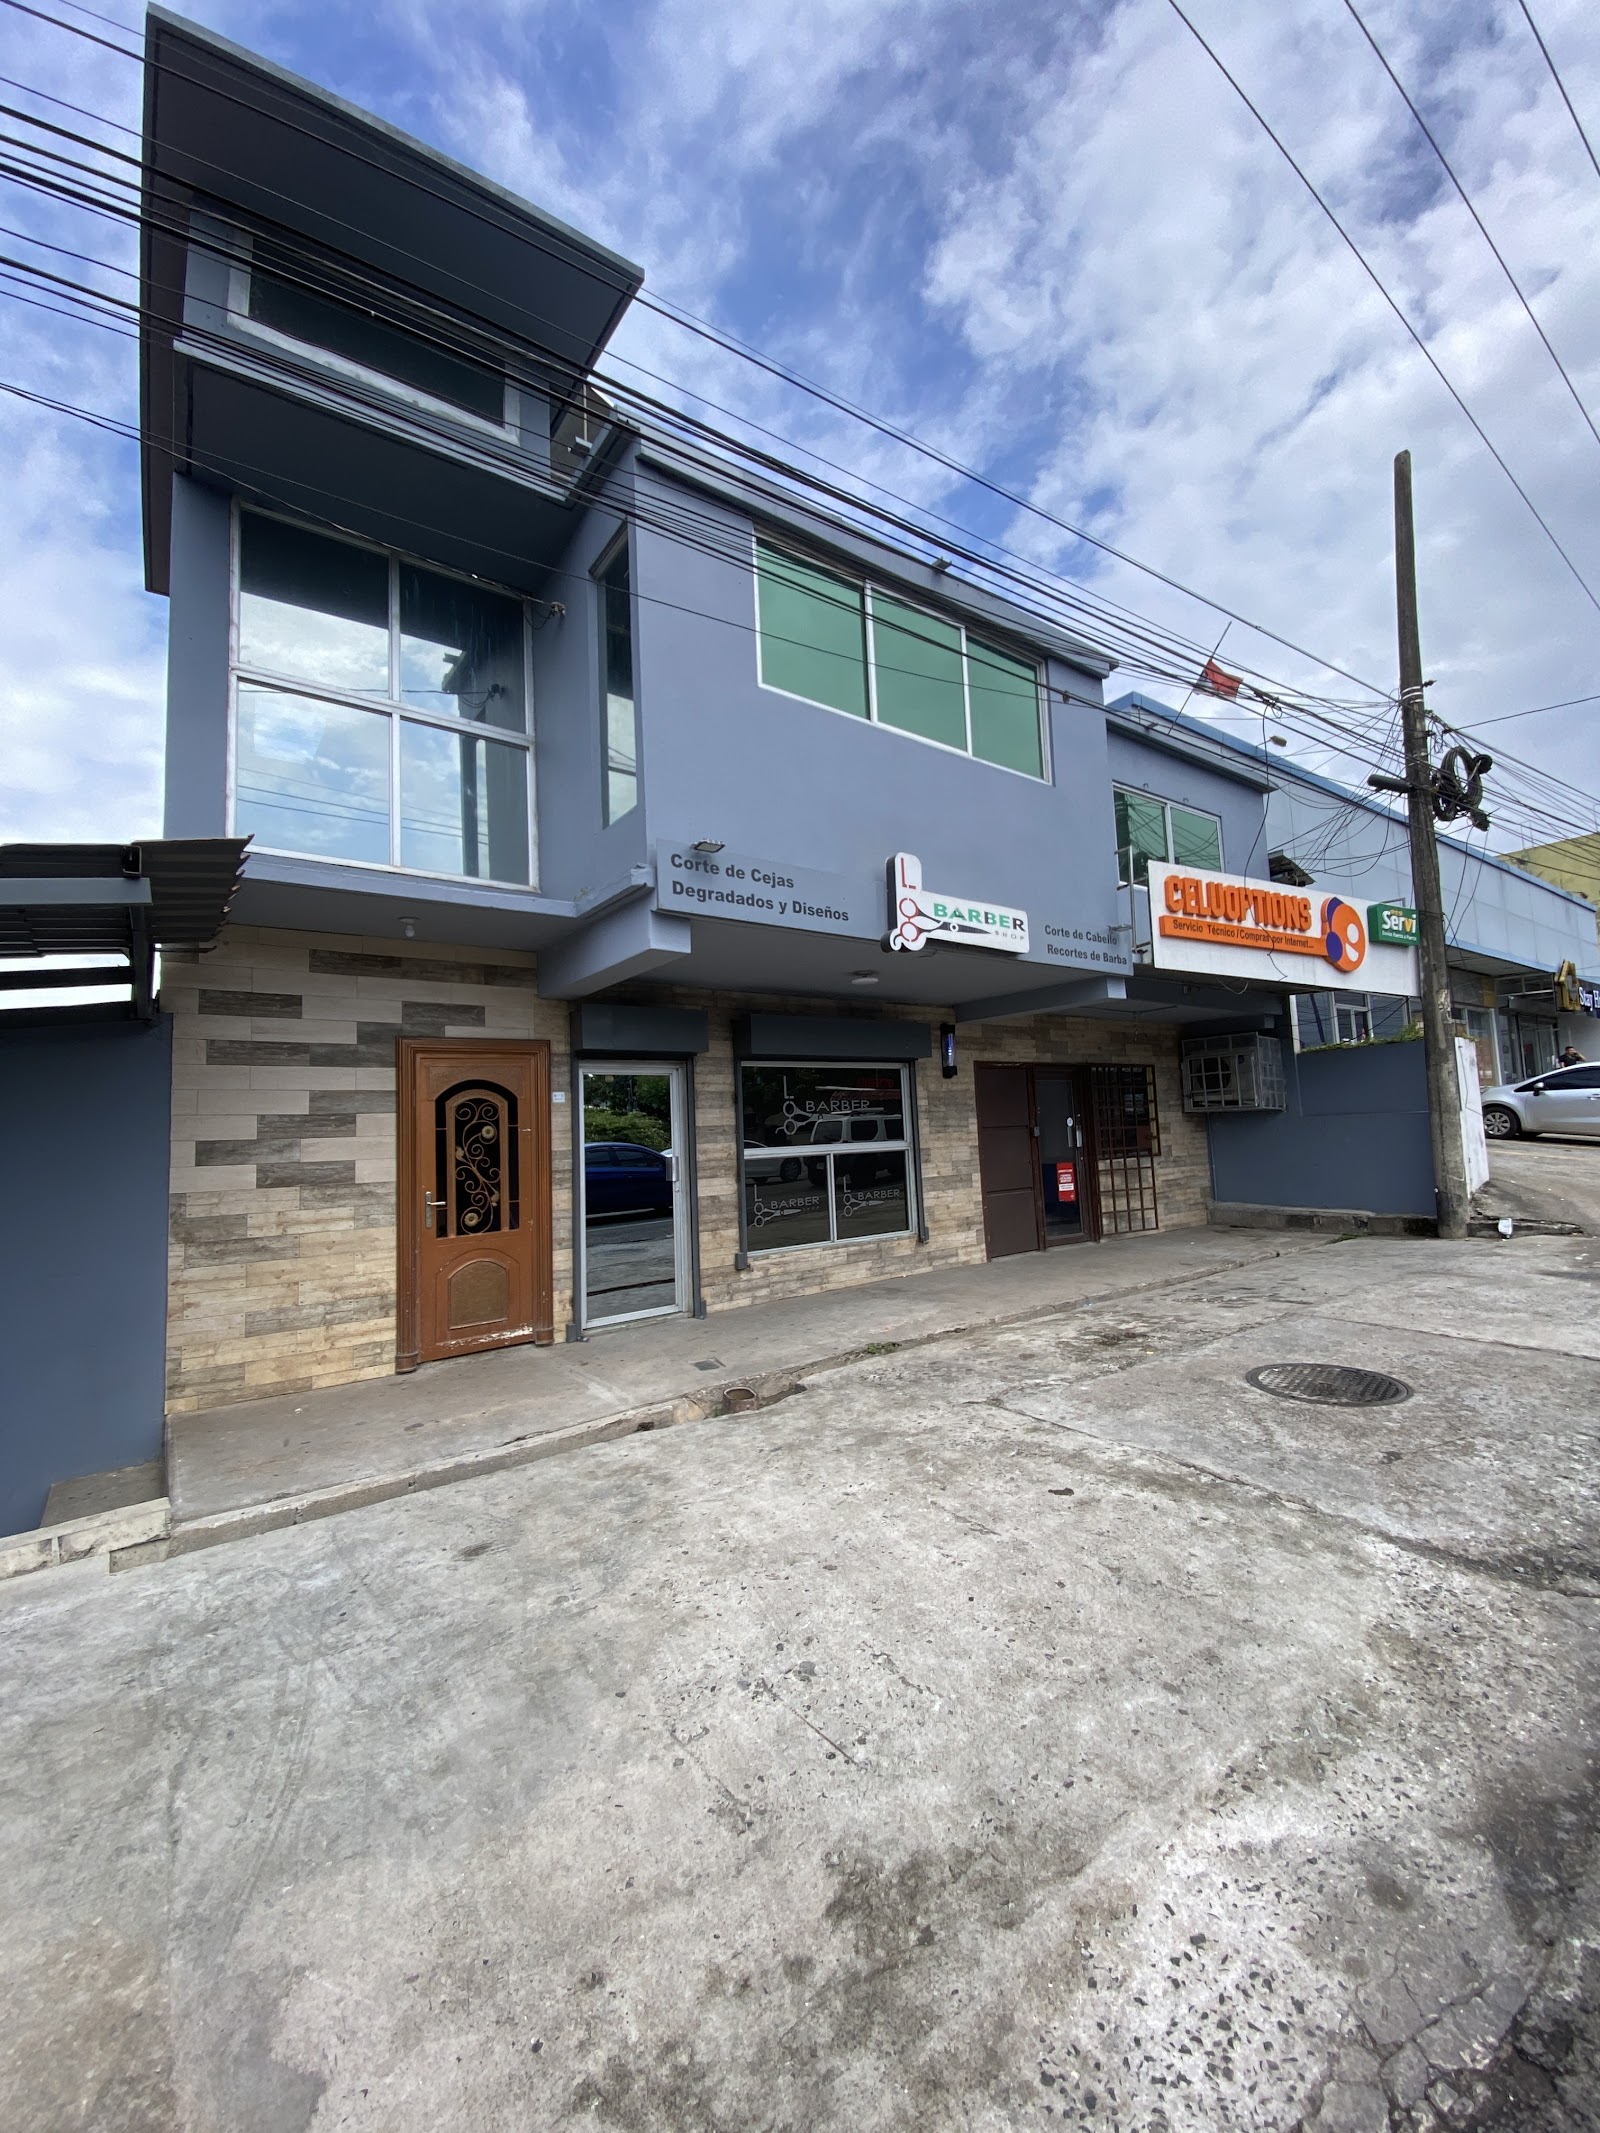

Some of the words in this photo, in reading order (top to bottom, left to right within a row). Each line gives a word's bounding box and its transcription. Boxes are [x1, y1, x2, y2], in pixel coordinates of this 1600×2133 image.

[670, 853, 720, 875] Corte
[725, 864, 746, 879] de
[750, 868, 795, 889] Cejas
[672, 880, 774, 910] Degradados
[778, 901, 787, 915] y
[792, 900, 850, 921] Diseños
[1164, 874, 1312, 932] CELUOPTIONS
[933, 902, 1027, 932] BARBER
[1381, 910, 1417, 934] Servi
[1044, 924, 1070, 938] Corte
[1072, 929, 1083, 940] de
[1085, 931, 1118, 945] Cabello
[1172, 919, 1204, 933] Servicio
[1207, 924, 1236, 938] Técnico
[1273, 935, 1283, 945] por
[1046, 943, 1088, 960] Recortes
[1090, 950, 1101, 961] de
[1102, 951, 1128, 965] Barba
[805, 1100, 871, 1114] BARBER
[770, 1195, 820, 1210] BARBER
[857, 1188, 901, 1201] BARBER
